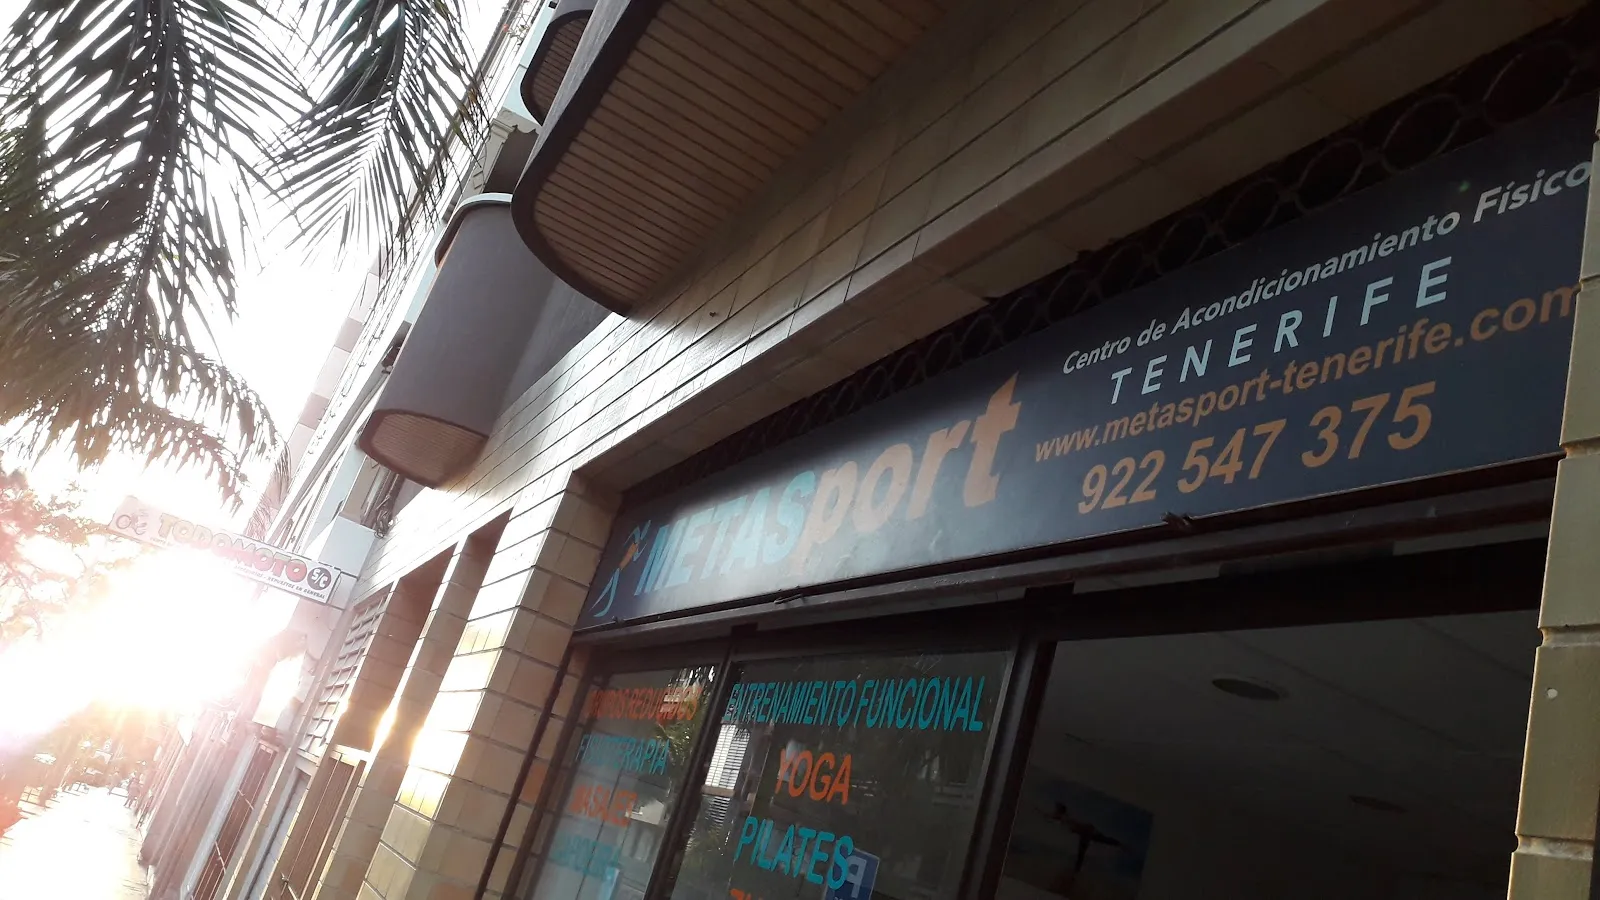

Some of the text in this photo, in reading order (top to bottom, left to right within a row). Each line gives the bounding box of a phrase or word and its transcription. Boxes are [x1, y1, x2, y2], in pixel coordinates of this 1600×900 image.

[1063, 161, 1592, 375] Centro de Acondicionamiento Físico
[1110, 256, 1452, 405] TENERIFE
[1035, 282, 1582, 463] www.metasport-tenerife.com
[634, 372, 1022, 597] METASport
[1077, 381, 1436, 515] 922 547 375
[158, 512, 308, 583] TODOMOTO
[721, 676, 985, 732] ENTRENAMIENTO FUNCIONAL
[775, 748, 852, 805] YOGA
[734, 815, 854, 890] PILATES
